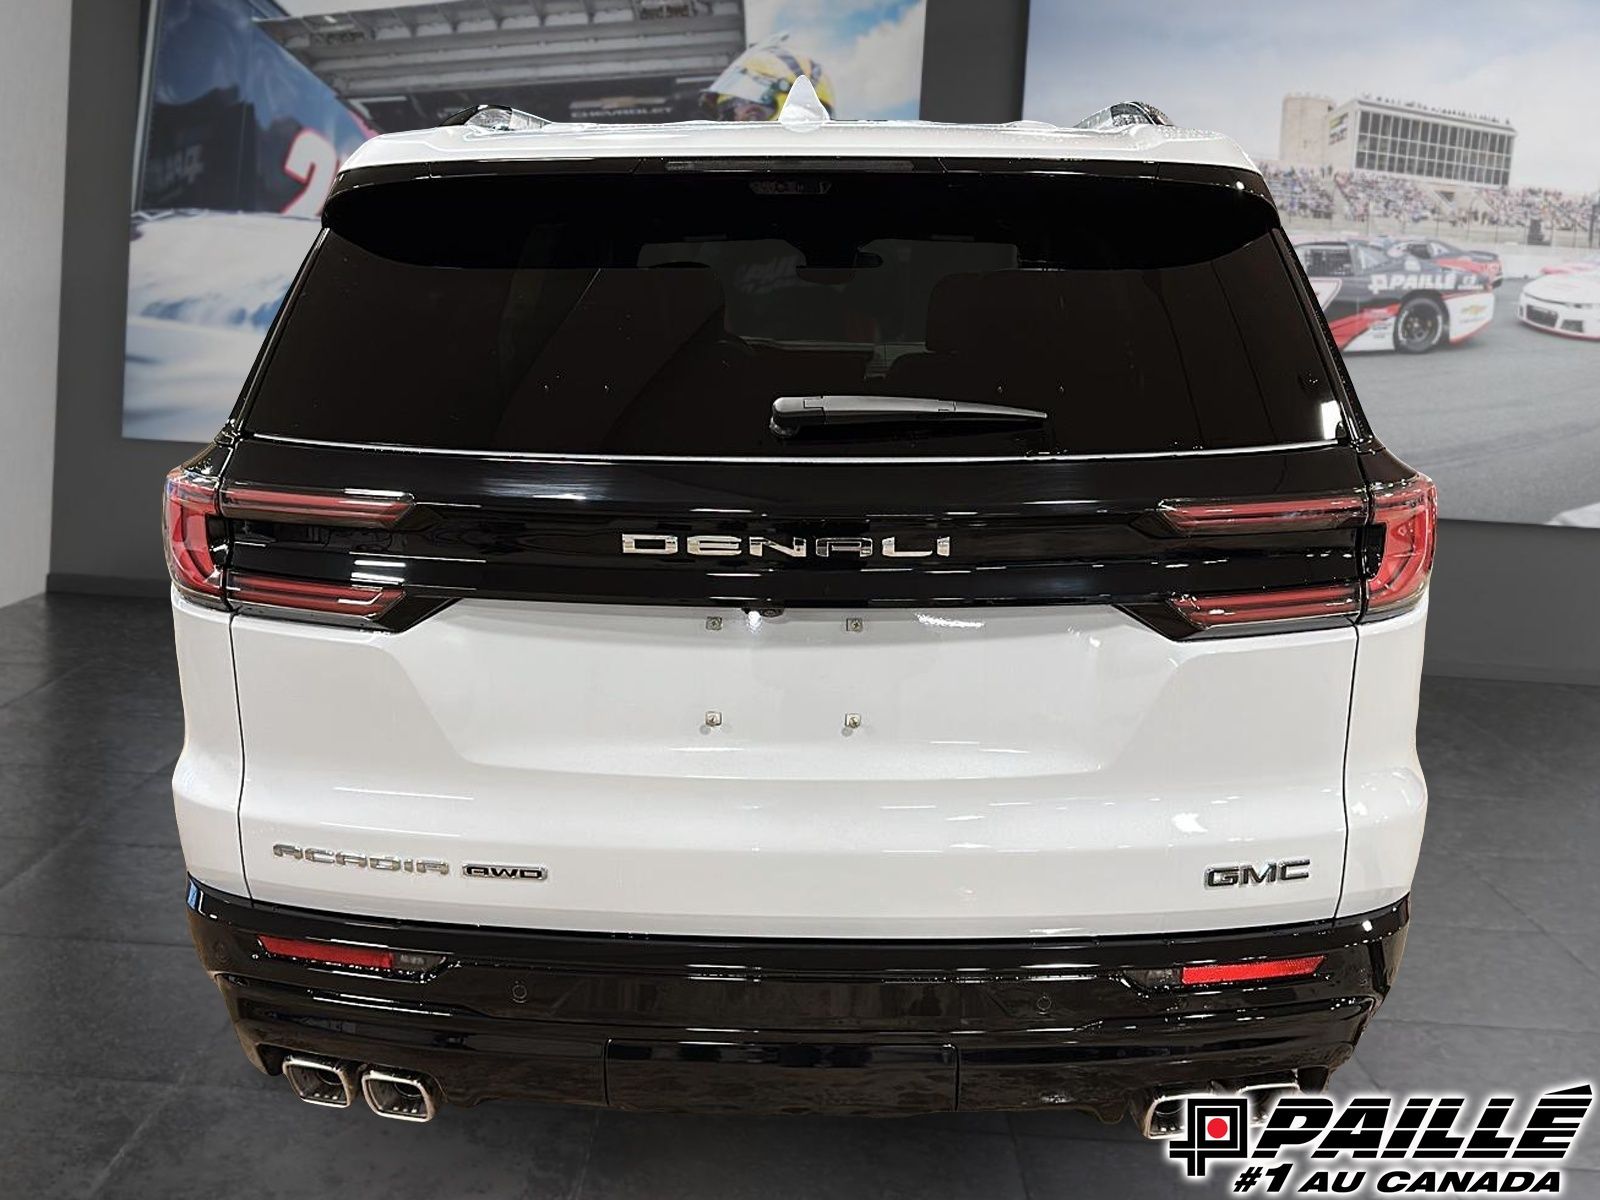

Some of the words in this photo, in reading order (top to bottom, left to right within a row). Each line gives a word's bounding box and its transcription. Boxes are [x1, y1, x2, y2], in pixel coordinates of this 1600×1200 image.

[622, 533, 950, 558] DENALI
[272, 843, 450, 875] ACADIA
[465, 865, 545, 880] AWD
[1204, 858, 1310, 888] GMC
